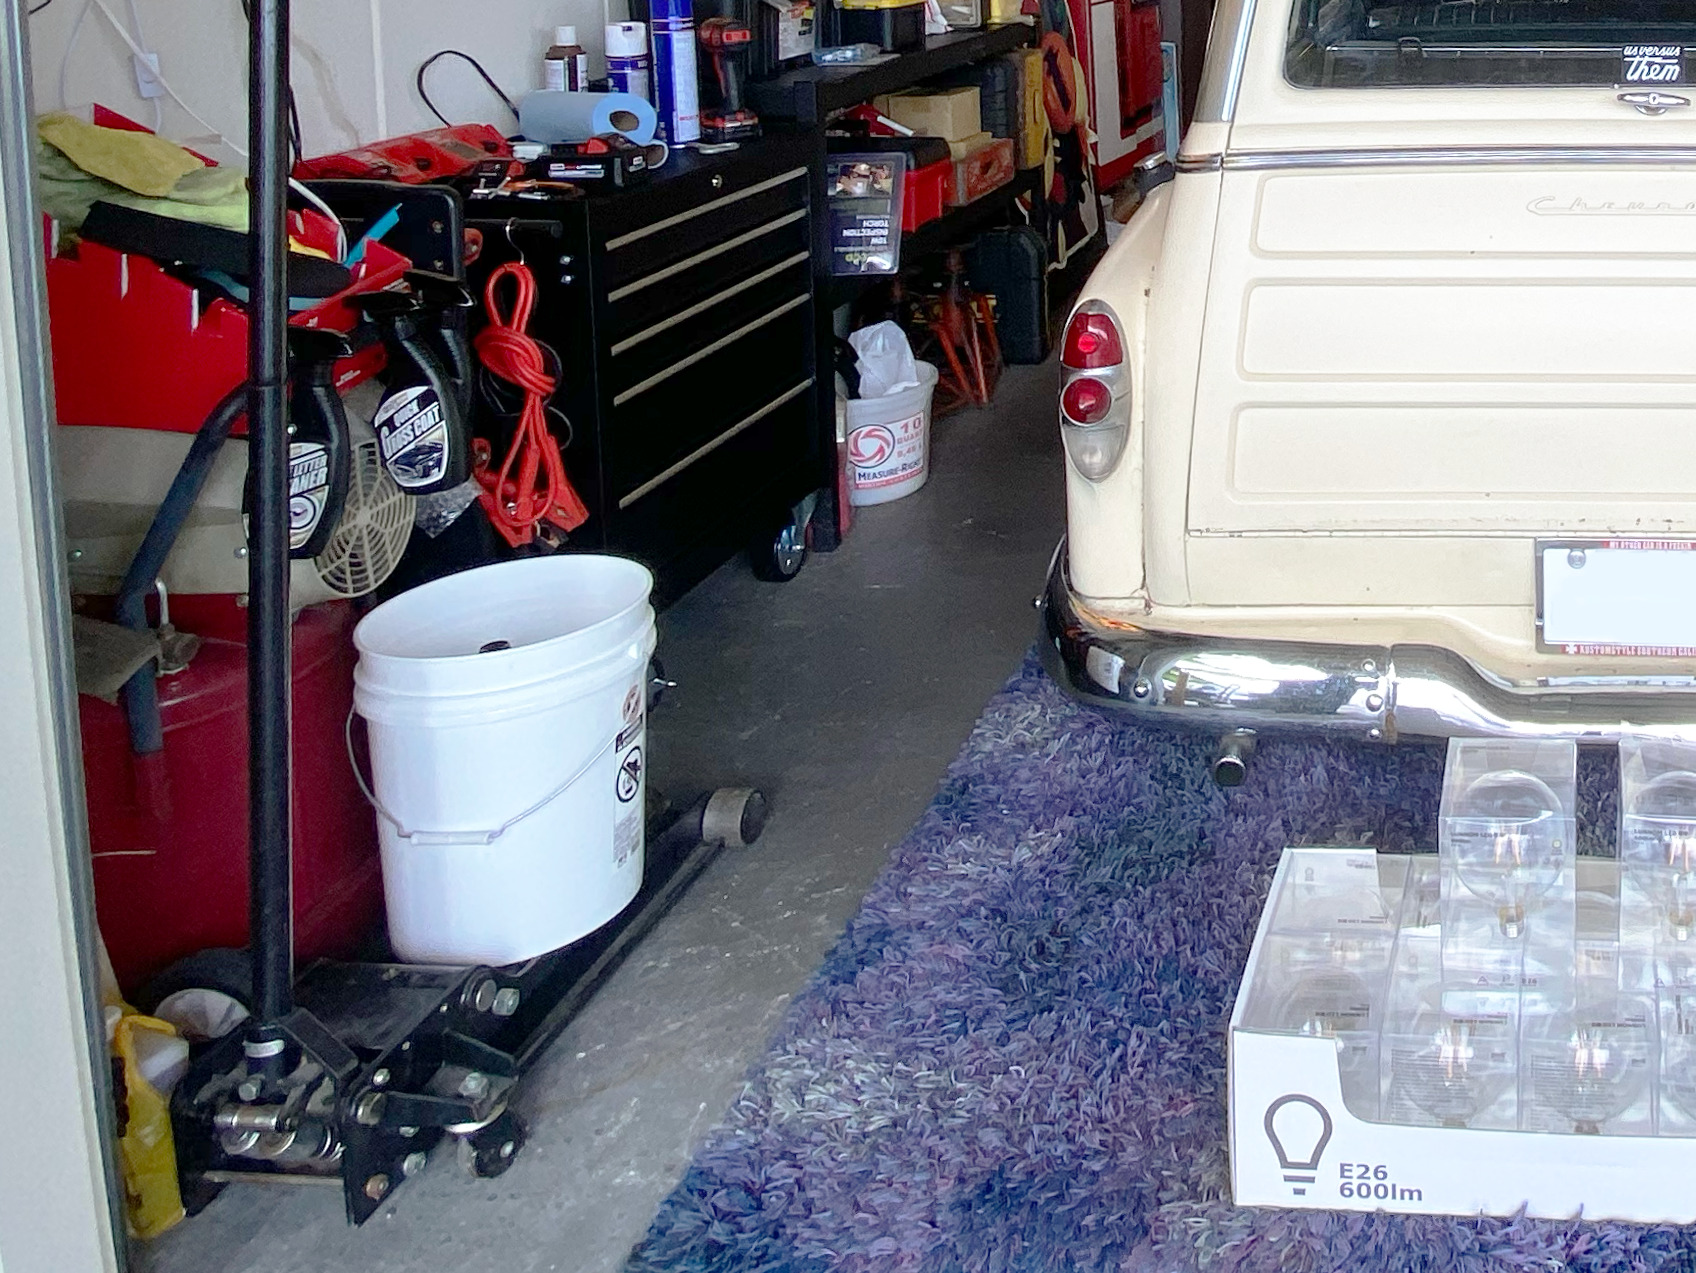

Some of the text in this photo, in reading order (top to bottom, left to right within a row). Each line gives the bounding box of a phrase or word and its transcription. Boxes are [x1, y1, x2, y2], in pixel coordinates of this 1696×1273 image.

[1623, 45, 1682, 57] us versus
[1625, 56, 1681, 82] them
[413, 406, 440, 438] COAT
[1339, 1162, 1388, 1181] E26
[1339, 1181, 1423, 1202] 600lm
